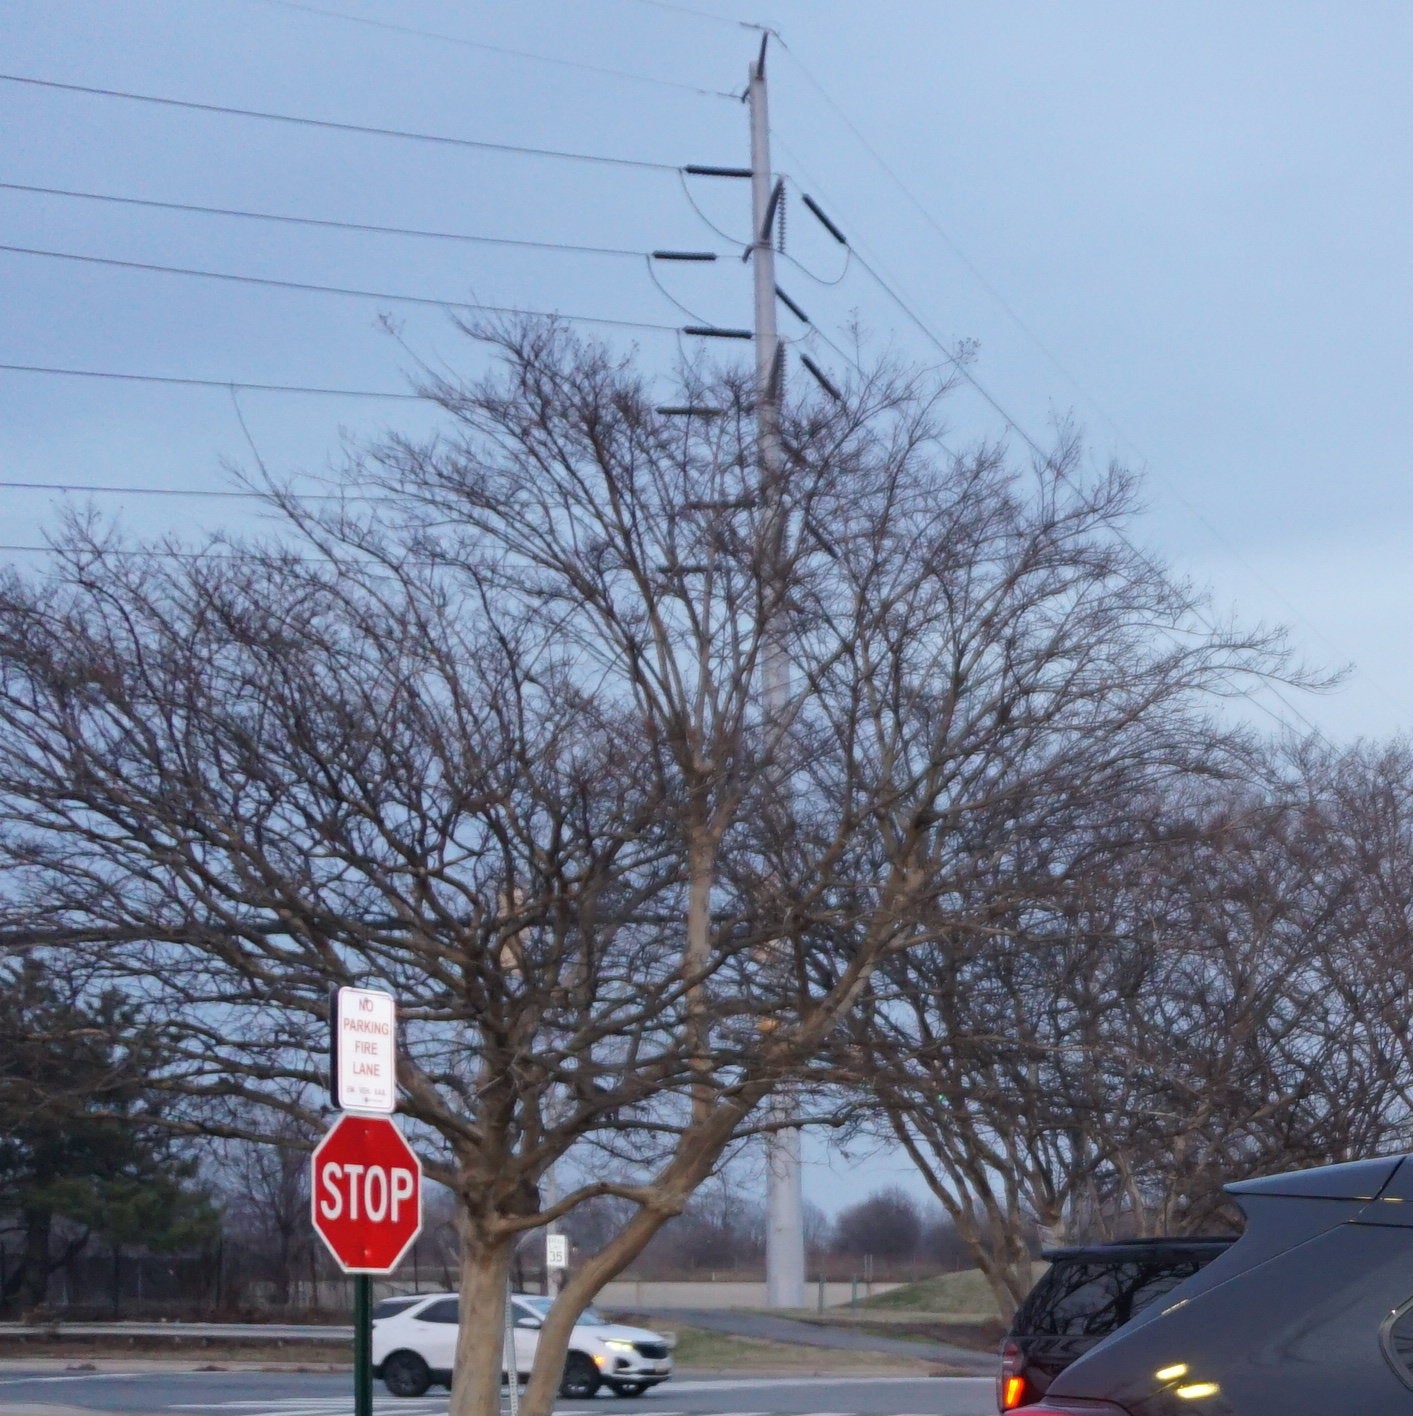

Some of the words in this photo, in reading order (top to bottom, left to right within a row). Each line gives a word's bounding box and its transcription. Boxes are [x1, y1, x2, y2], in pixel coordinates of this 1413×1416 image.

[358, 997, 374, 1013] NO
[343, 1017, 389, 1036] PARKING
[355, 1039, 378, 1056] FIRE
[352, 1060, 381, 1077] LANE
[320, 1161, 414, 1224] STOP
